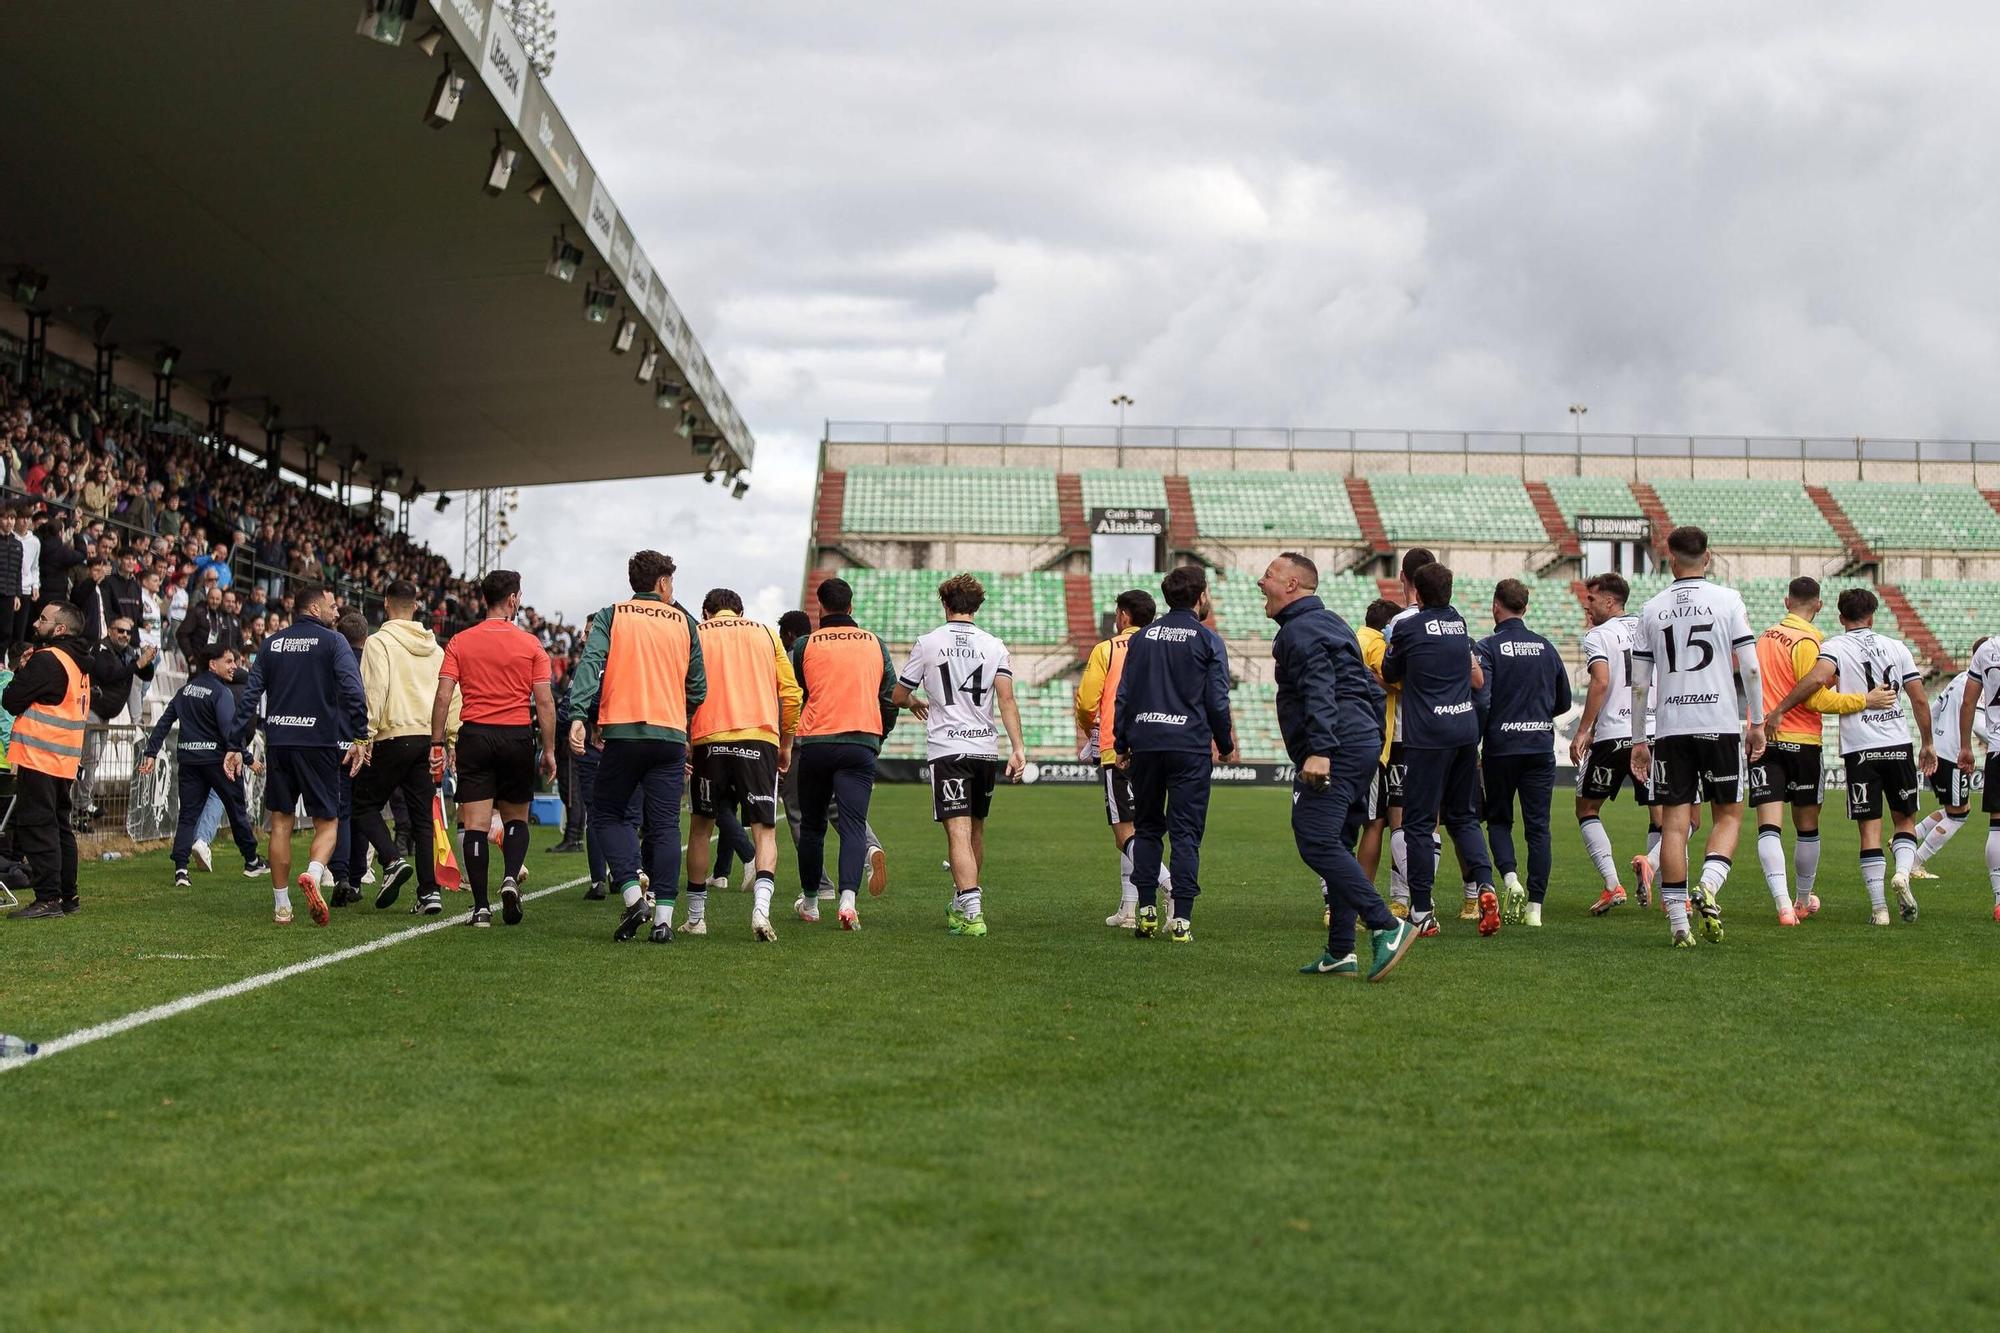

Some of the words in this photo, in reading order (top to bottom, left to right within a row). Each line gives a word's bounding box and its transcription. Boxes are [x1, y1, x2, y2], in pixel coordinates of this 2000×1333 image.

[617, 604, 682, 623] macron
[1658, 605, 1713, 621] GAIZKA
[698, 618, 760, 631] macron
[284, 637, 319, 646] CASAMAYOR
[812, 631, 873, 643] macron
[282, 643, 310, 652] PERFILES
[937, 647, 986, 660] ARTOLA
[1660, 621, 1716, 674] 15
[936, 660, 988, 707] 14
